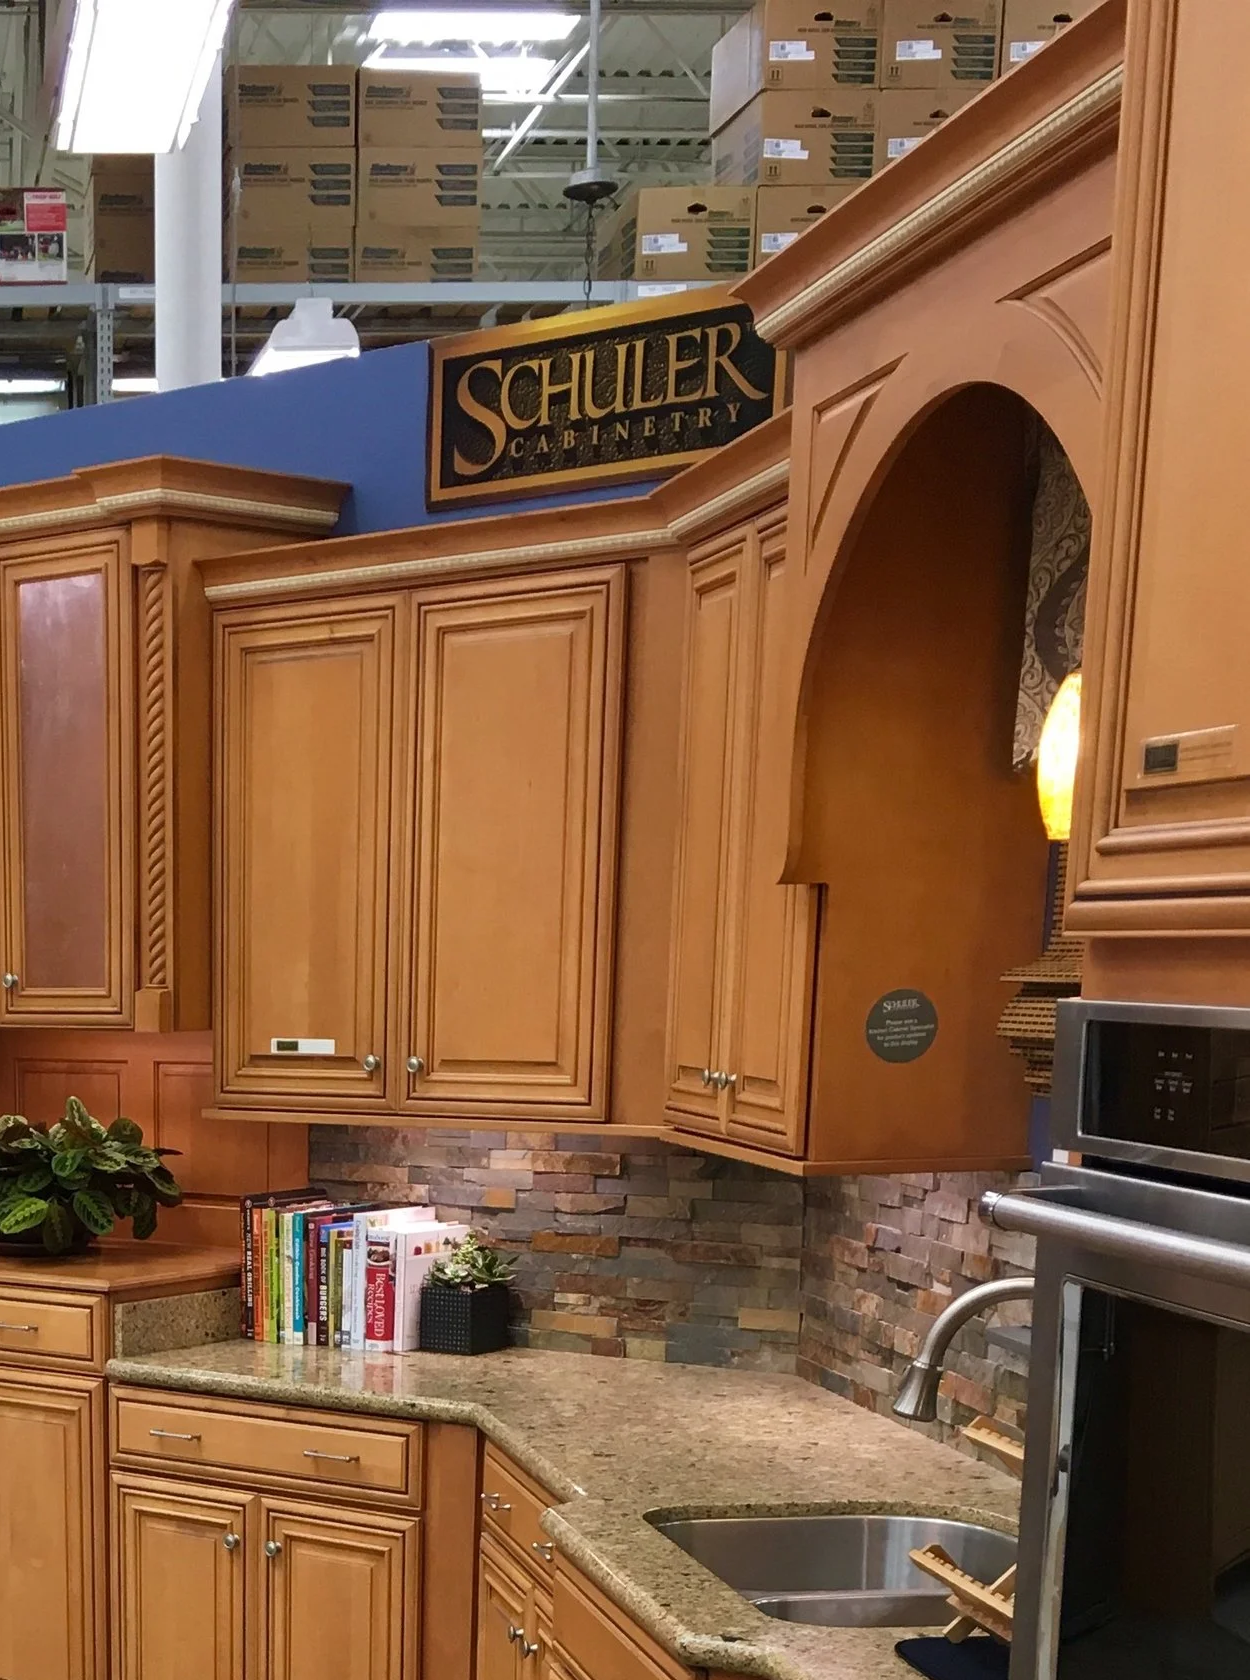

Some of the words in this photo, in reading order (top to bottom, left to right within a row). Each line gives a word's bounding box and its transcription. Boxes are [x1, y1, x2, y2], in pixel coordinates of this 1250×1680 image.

[453, 321, 769, 477] SCHULER
[509, 403, 743, 459] CABINETRY
[320, 1275, 327, 1284] OF
[374, 1273, 386, 1300] Best
[319, 1284, 328, 1322] BURGERS
[374, 1300, 386, 1338] LOVED
